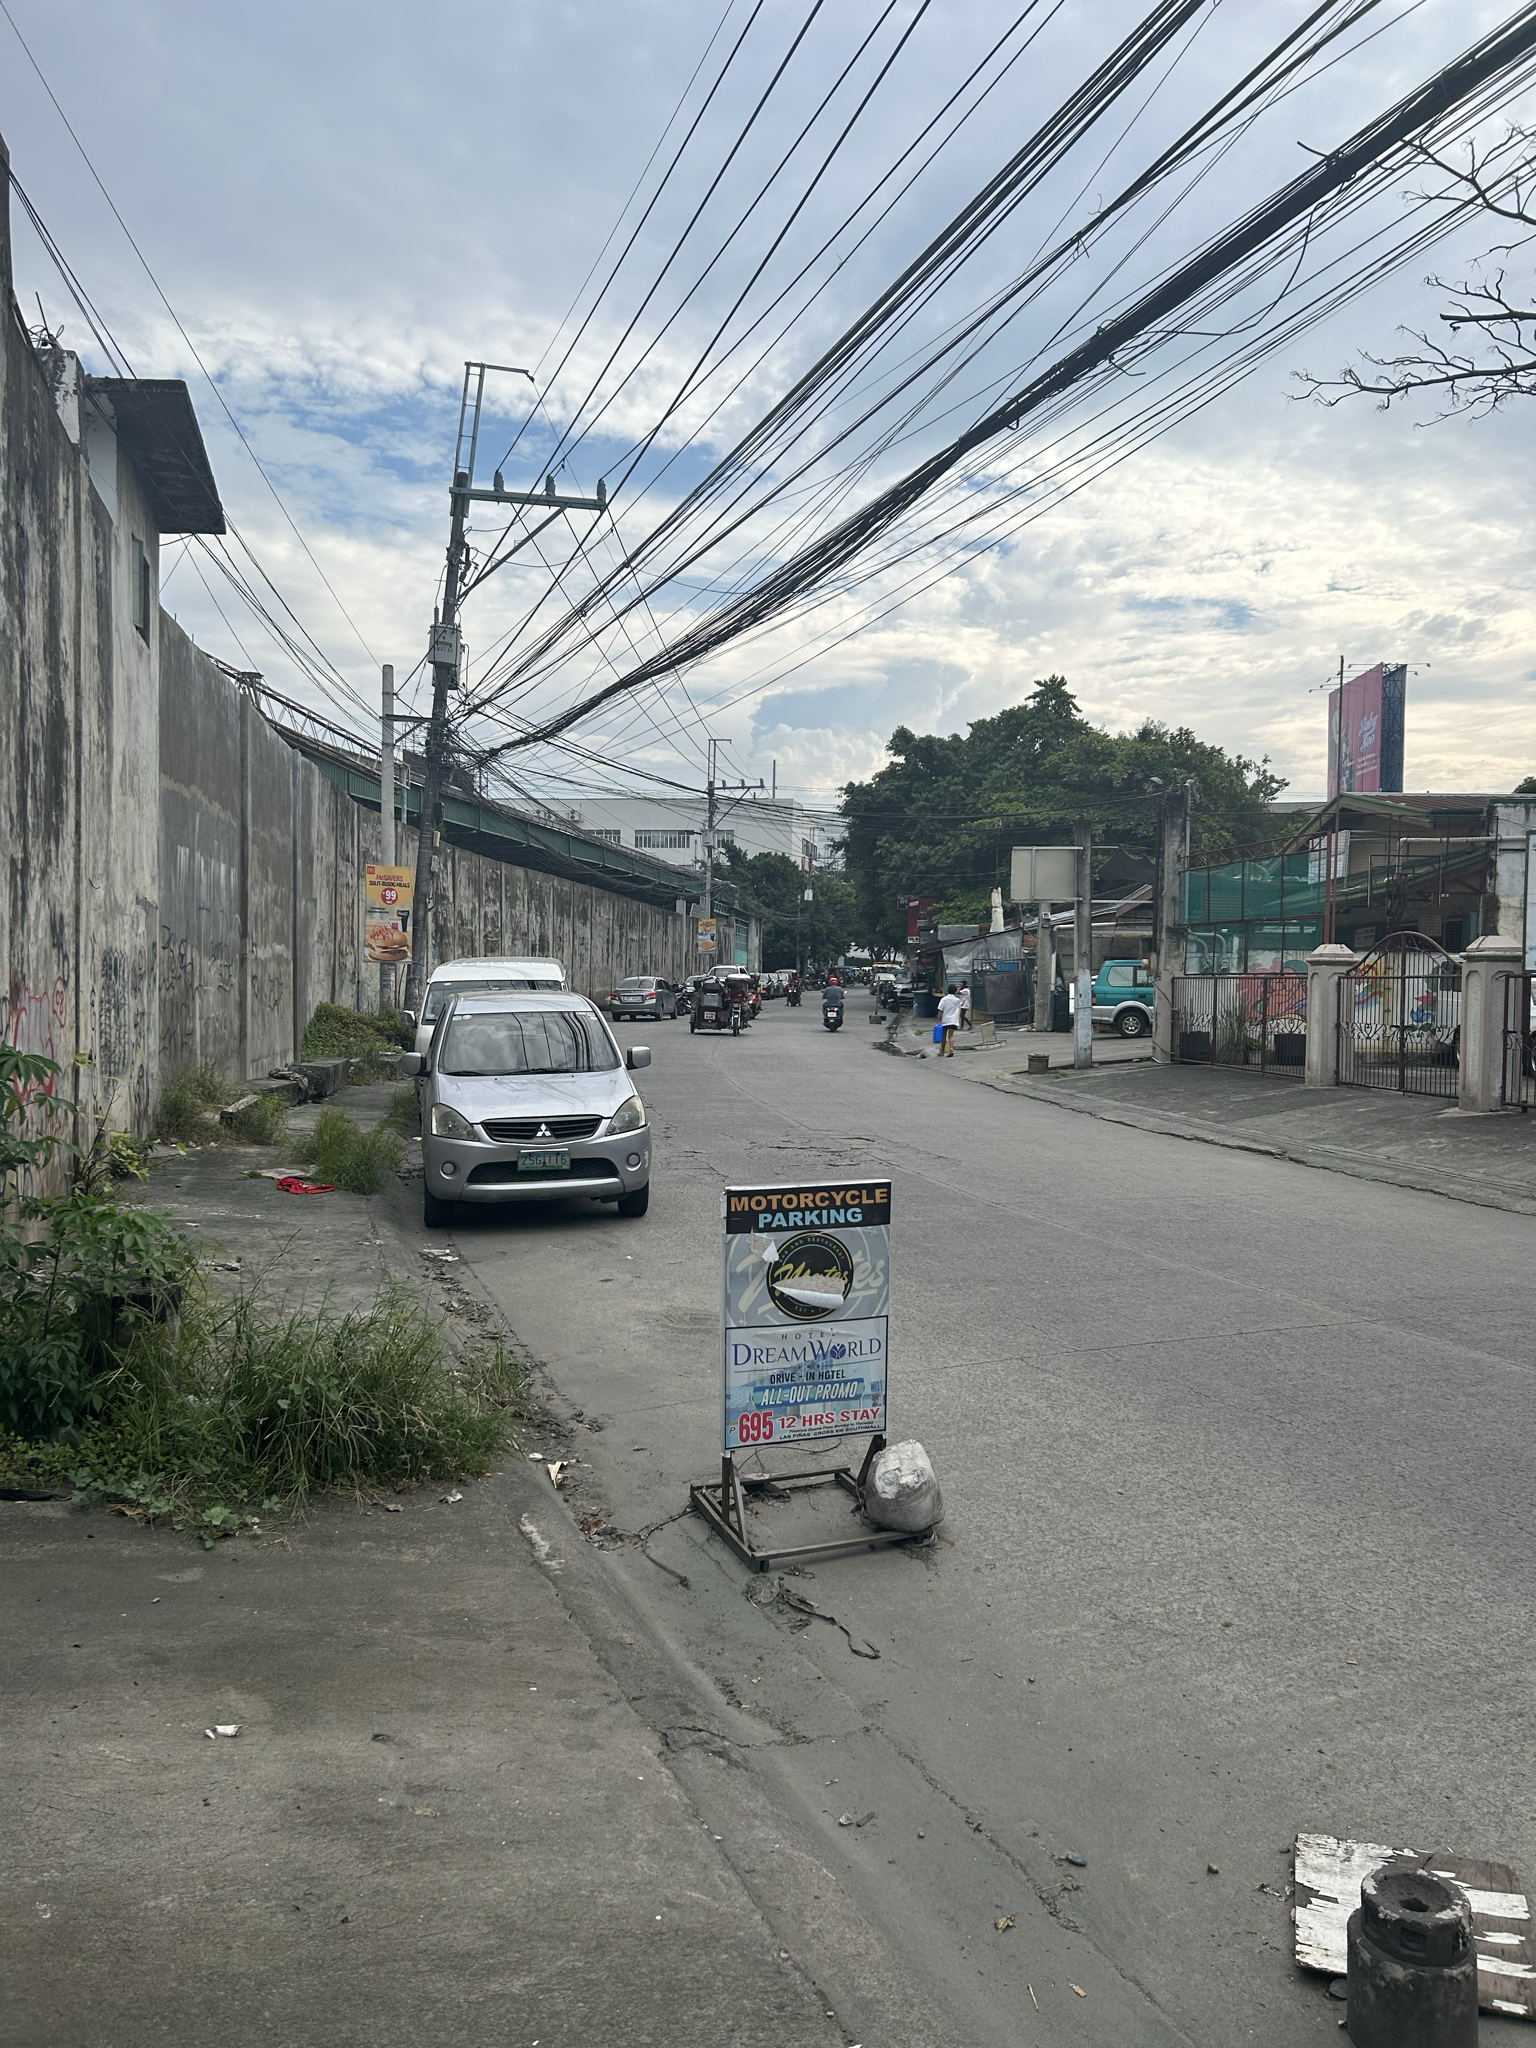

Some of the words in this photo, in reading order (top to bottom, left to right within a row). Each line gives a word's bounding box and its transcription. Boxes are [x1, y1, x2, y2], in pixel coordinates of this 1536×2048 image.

[522, 1155, 541, 1166] ZSG
[730, 1188, 888, 1212] MOTORCYCLE
[758, 1207, 863, 1228] PARKING
[781, 1328, 836, 1340] HOTEL
[770, 1372, 796, 1385] DRIVE
[805, 1371, 815, 1381] IN
[818, 1369, 846, 1380] HOTEL
[760, 1384, 811, 1406] ALL-OUT
[814, 1381, 858, 1400] PROMO
[778, 1417, 797, 1429] 12
[802, 1412, 835, 1427] HRS
[840, 1407, 880, 1422] STAY
